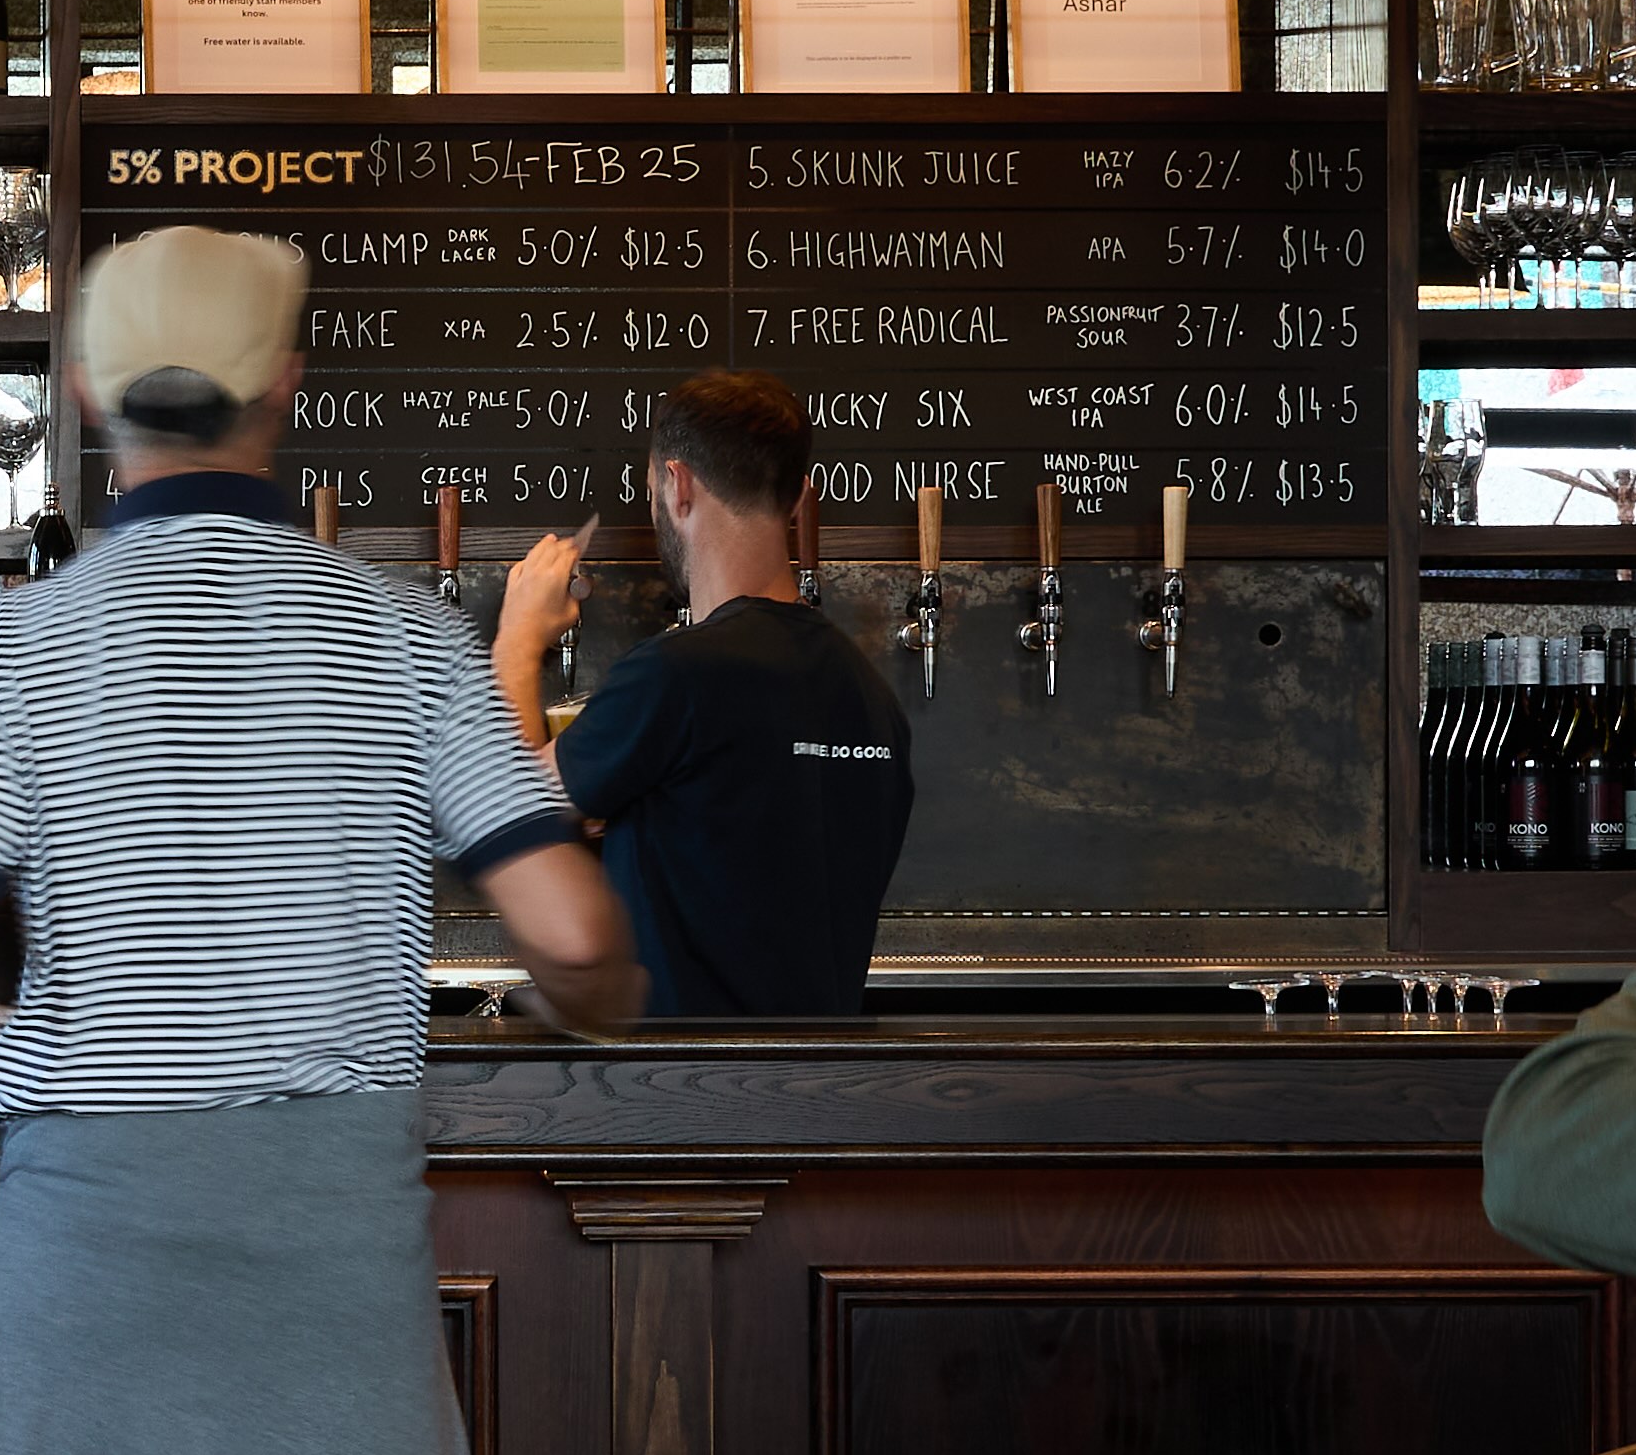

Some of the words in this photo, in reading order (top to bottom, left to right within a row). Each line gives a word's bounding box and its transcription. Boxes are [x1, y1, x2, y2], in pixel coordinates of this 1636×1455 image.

[262, 38, 305, 46] available.
[640, 143, 700, 182] 25
[786, 148, 905, 188] SKUNK
[923, 150, 1021, 186] JUICE
[1083, 150, 1134, 169] HAZY
[108, 148, 162, 184] 5%
[173, 149, 364, 194] PROJECT
[1095, 172, 1124, 189] IPA
[448, 228, 489, 243] DARK
[321, 232, 429, 266] CLAMP
[441, 246, 496, 263] LAGER
[790, 230, 1004, 271] HIGHWAYMAN
[1087, 236, 1126, 262] APA
[1046, 304, 1165, 324] PASSIONFRUIT
[311, 309, 398, 349] FAKE
[444, 319, 486, 341] XPA
[791, 306, 865, 345] FREE
[878, 305, 1009, 346] RADICAL
[1076, 327, 1128, 349] SOUR
[403, 390, 453, 410] HAZY
[467, 390, 510, 410] PALE
[1028, 386, 1079, 407] WEST
[1090, 383, 1155, 406] COAST
[294, 390, 384, 430] ROCK
[437, 411, 472, 429] ALE
[807, 389, 888, 431] UCKY
[916, 389, 972, 428] SIX
[1071, 407, 1104, 429] IPA
[1043, 452, 1140, 473] HAND-PULL
[421, 466, 487, 485] CZECH
[1055, 473, 1128, 495] BURTON
[1076, 497, 1103, 514] ALE
[831, 746, 850, 758] DO
[1509, 824, 1547, 834] KONO
[1590, 823, 1624, 834] KONO
